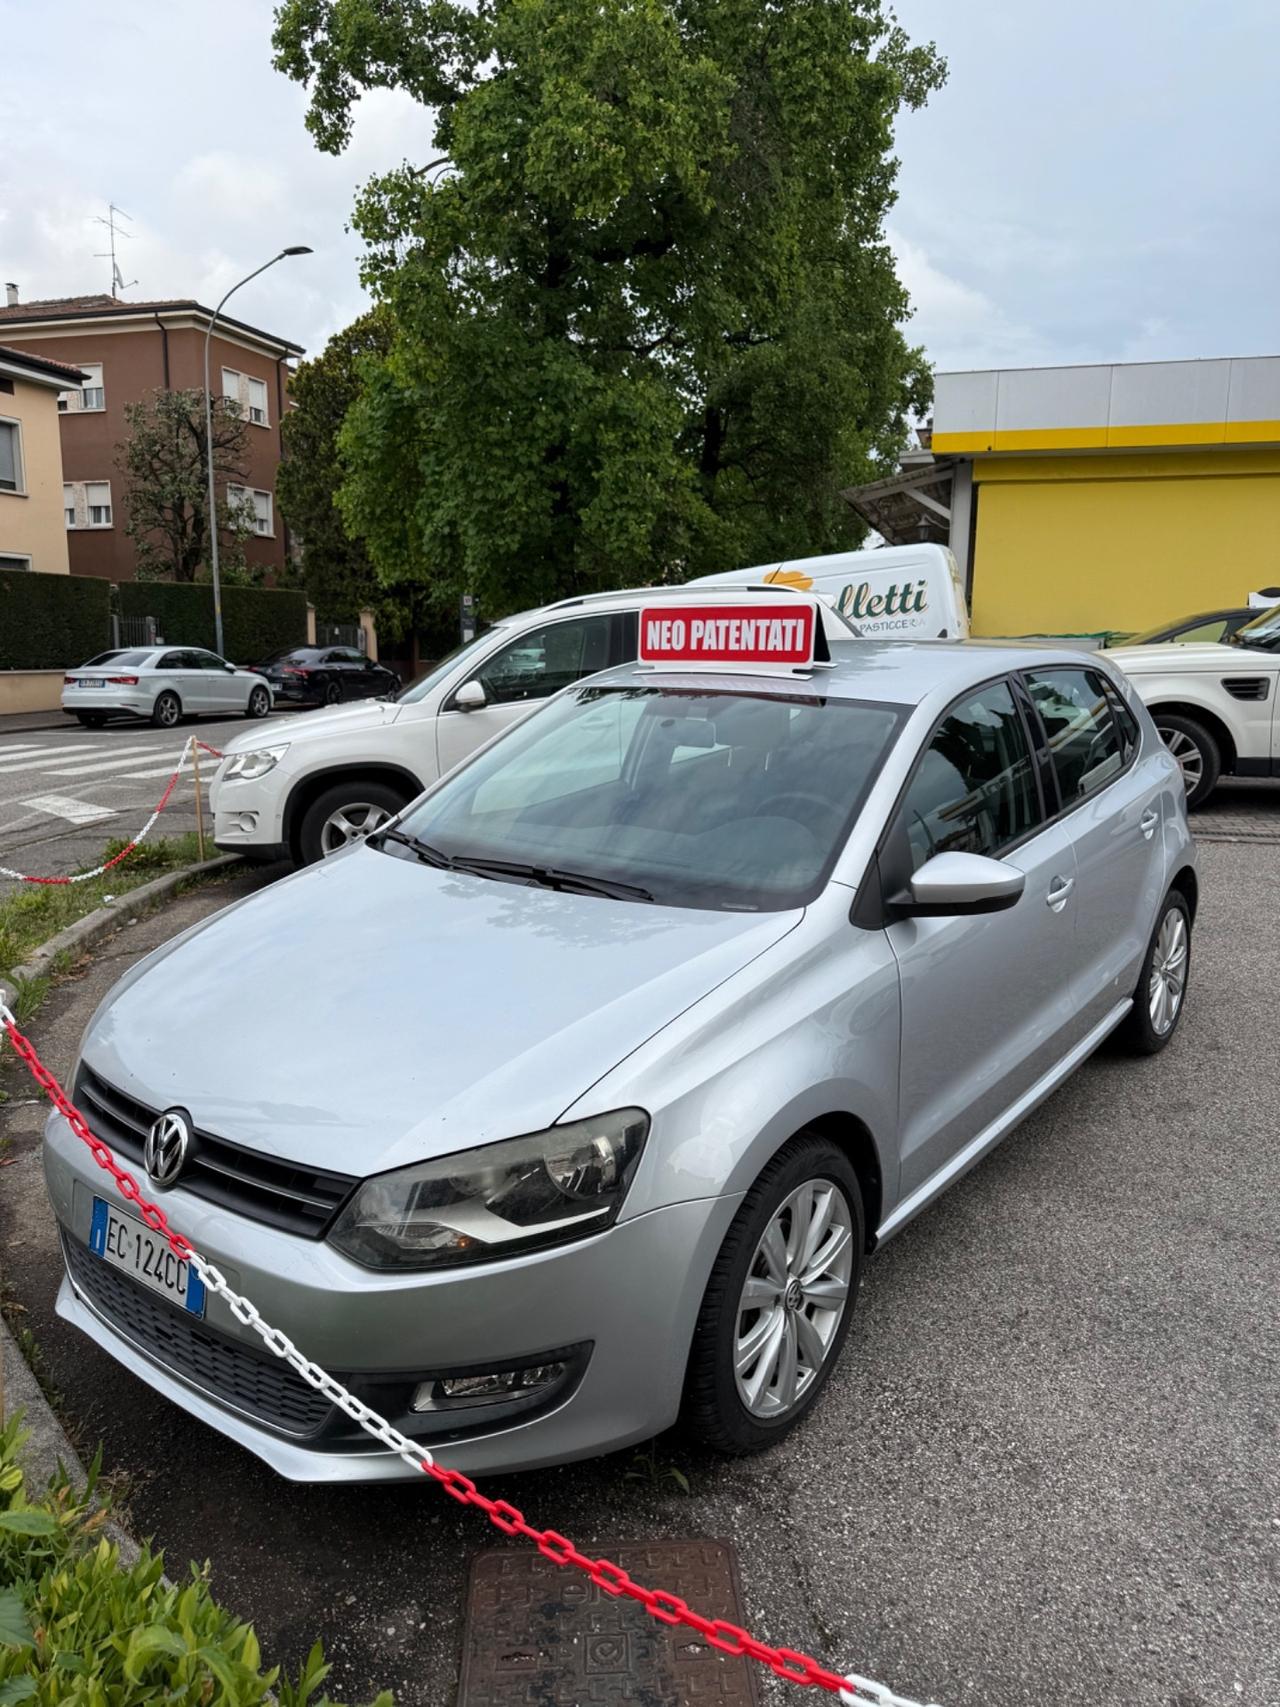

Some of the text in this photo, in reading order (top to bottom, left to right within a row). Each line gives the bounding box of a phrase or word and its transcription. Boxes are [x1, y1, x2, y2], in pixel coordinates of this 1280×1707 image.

[837, 579, 930, 621] lletti
[647, 618, 805, 652] NEO PATENTATI
